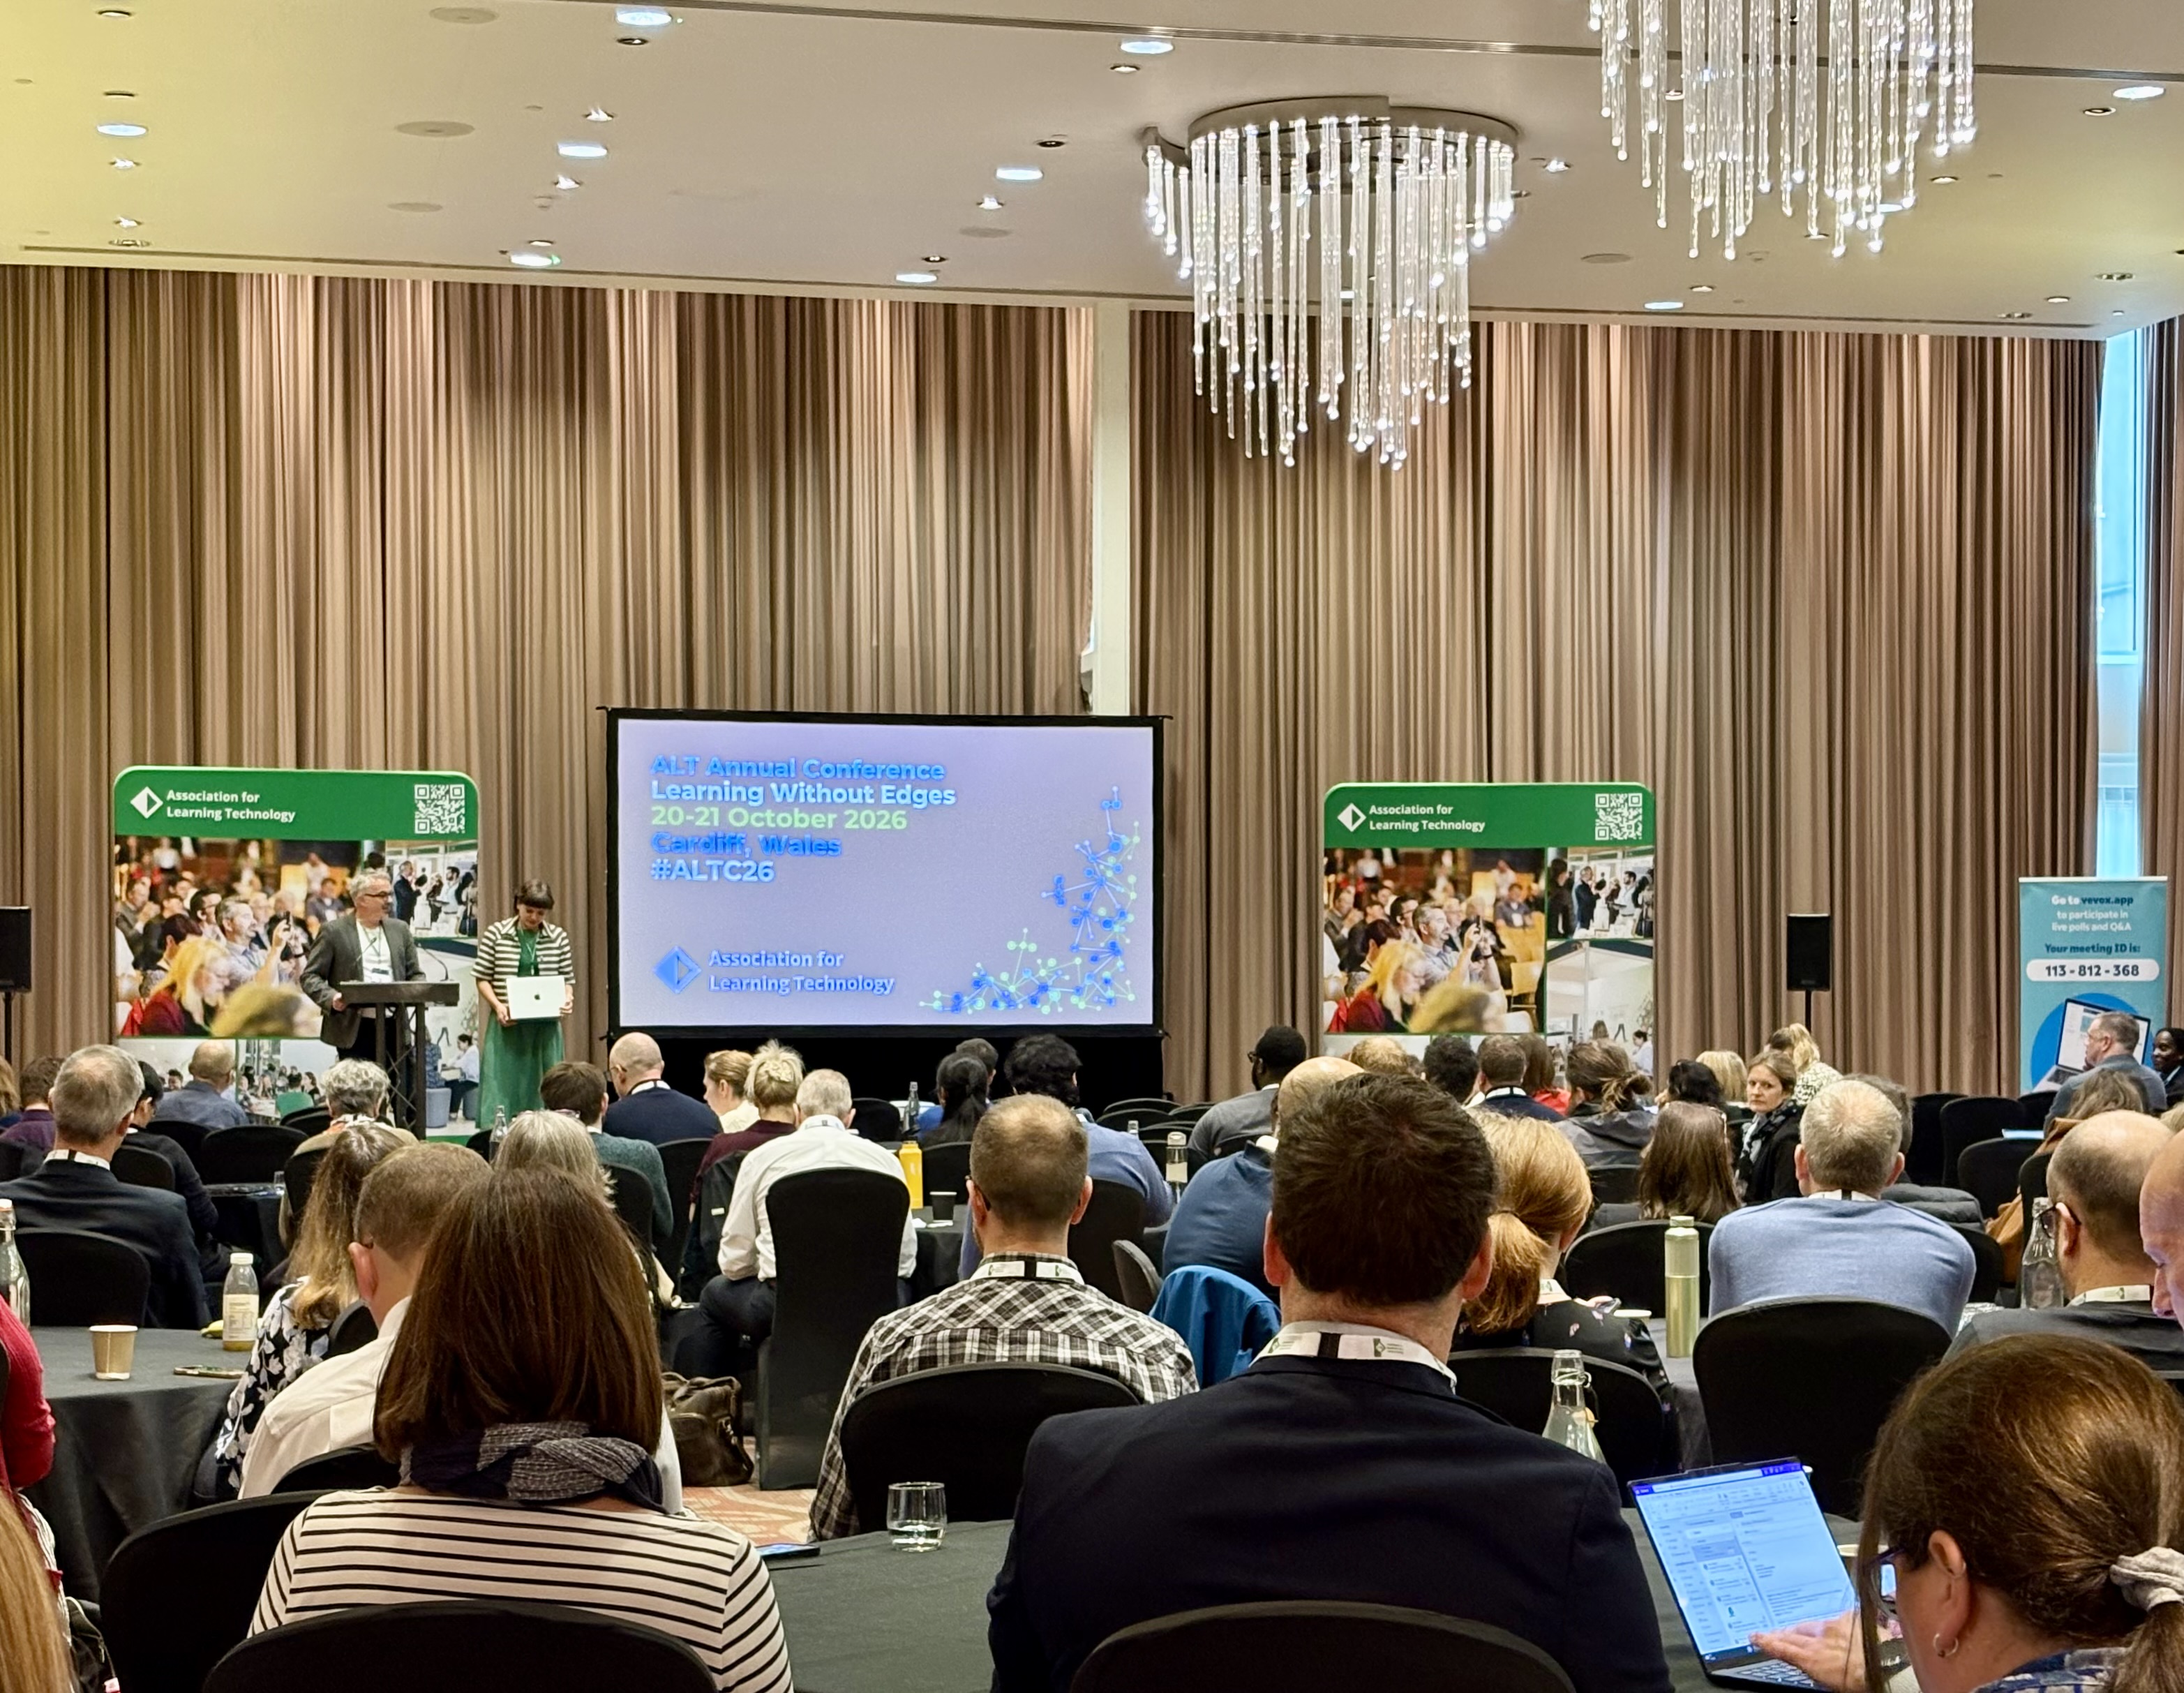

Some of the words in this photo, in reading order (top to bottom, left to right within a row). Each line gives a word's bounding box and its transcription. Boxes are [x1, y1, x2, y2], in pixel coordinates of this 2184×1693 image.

[651, 756, 699, 776] ALT
[705, 757, 795, 777] Annual
[803, 759, 945, 780] Conference
[167, 790, 239, 803] Association
[241, 791, 260, 803] for
[652, 781, 765, 806] Learning
[770, 782, 875, 804] Without
[881, 784, 955, 808] Edges
[167, 807, 222, 821] Learning
[225, 808, 295, 823] Technology
[1369, 805, 1434, 814] Association
[1437, 805, 1453, 814] for
[652, 806, 720, 827] 20-21
[728, 808, 837, 829] October
[844, 810, 906, 830] 2026
[1370, 820, 1419, 832] Learning
[1421, 820, 1485, 833] Technology
[652, 832, 752, 858] Cardiff,
[758, 834, 842, 856] Wales
[650, 860, 775, 883] #ALTC26
[2051, 895, 2066, 905] Go
[2068, 896, 2079, 904] to
[2081, 896, 2133, 907] vevox.app
[2057, 910, 2067, 918] to
[2069, 910, 2118, 921] participate
[2052, 922, 2067, 931] live
[2069, 923, 2089, 932] polls
[2091, 923, 2108, 931] and
[2110, 923, 2132, 931] Q&A
[2045, 944, 2068, 953] Your
[2070, 944, 2112, 955] meeting
[2114, 944, 2127, 953] ID
[2129, 944, 2140, 953] is:
[709, 950, 813, 967] Association
[817, 950, 844, 967] for
[2046, 965, 2066, 976] 113
[2078, 965, 2102, 976] 812
[2113, 965, 2139, 976] 368
[709, 975, 791, 994] Learning
[793, 976, 895, 995] Technology
